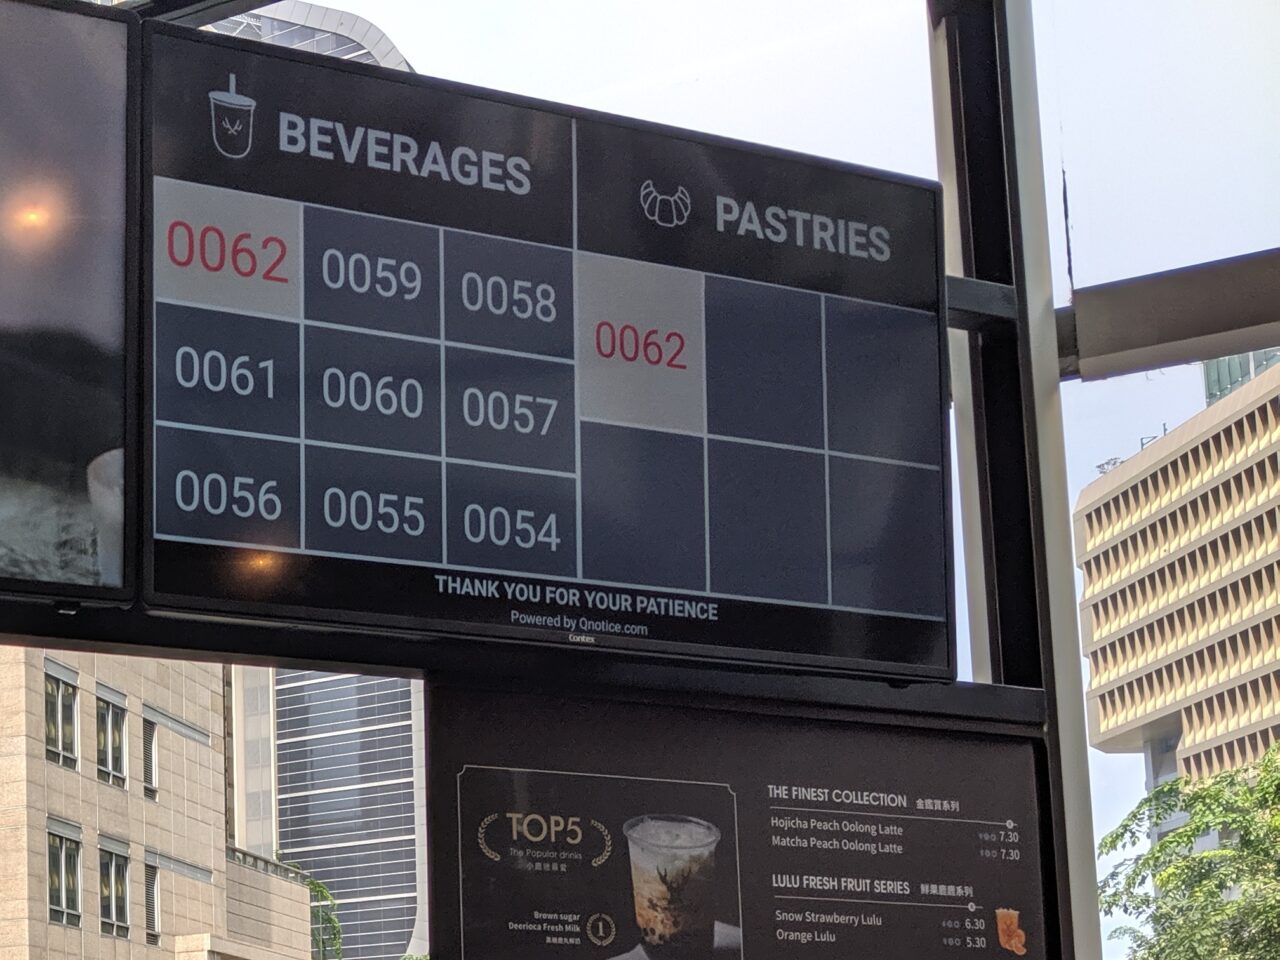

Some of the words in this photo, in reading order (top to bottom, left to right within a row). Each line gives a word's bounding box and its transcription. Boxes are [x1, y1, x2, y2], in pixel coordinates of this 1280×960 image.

[279, 111, 532, 196] BEVERAGES
[716, 196, 891, 262] PASTRIES
[167, 220, 288, 283] 0062
[322, 248, 422, 300] 0059
[461, 272, 557, 322] 0058
[595, 321, 687, 370] 0062
[174, 346, 276, 399] 0061
[322, 367, 423, 418] 0060
[463, 386, 558, 436] 0057
[174, 470, 283, 520] 0056
[323, 487, 426, 537] 0055
[463, 505, 561, 553] 0054
[434, 574, 500, 598] THANK
[503, 582, 540, 602] YOU
[546, 587, 580, 606] FOR
[584, 592, 632, 612] YOUR
[636, 596, 718, 621] PATIENCE
[511, 610, 560, 627] Powered
[563, 616, 577, 630] by
[579, 617, 648, 636] Qnotice.com
[569, 634, 594, 643] Contex
[768, 785, 788, 799] THE
[792, 787, 829, 801] FINEST
[832, 790, 907, 808] COLLECTION
[506, 812, 582, 844] TOP5
[771, 816, 808, 830] Hojicha
[810, 819, 840, 830] Peach
[842, 821, 877, 836] Oolong
[879, 824, 903, 836] Latte
[999, 831, 1018, 842] 7.30
[526, 849, 557, 859] Popular
[560, 850, 582, 859] drinks
[772, 836, 808, 847] Matcha
[810, 838, 840, 849] Peach
[842, 840, 876, 854] Oolong
[879, 842, 903, 853] Latte
[1001, 849, 1020, 860] 7.30
[772, 874, 799, 887] LULU
[803, 876, 837, 890] FRESH
[841, 878, 871, 892] FRUIT
[874, 880, 910, 894] SERIES
[775, 910, 803, 921] Snow
[805, 911, 859, 926] Strawberry
[861, 914, 882, 926] Lulu
[965, 919, 985, 929] 6.30
[776, 930, 811, 943] Orange
[813, 930, 836, 942] Lulu
[966, 937, 986, 947] 5.30
